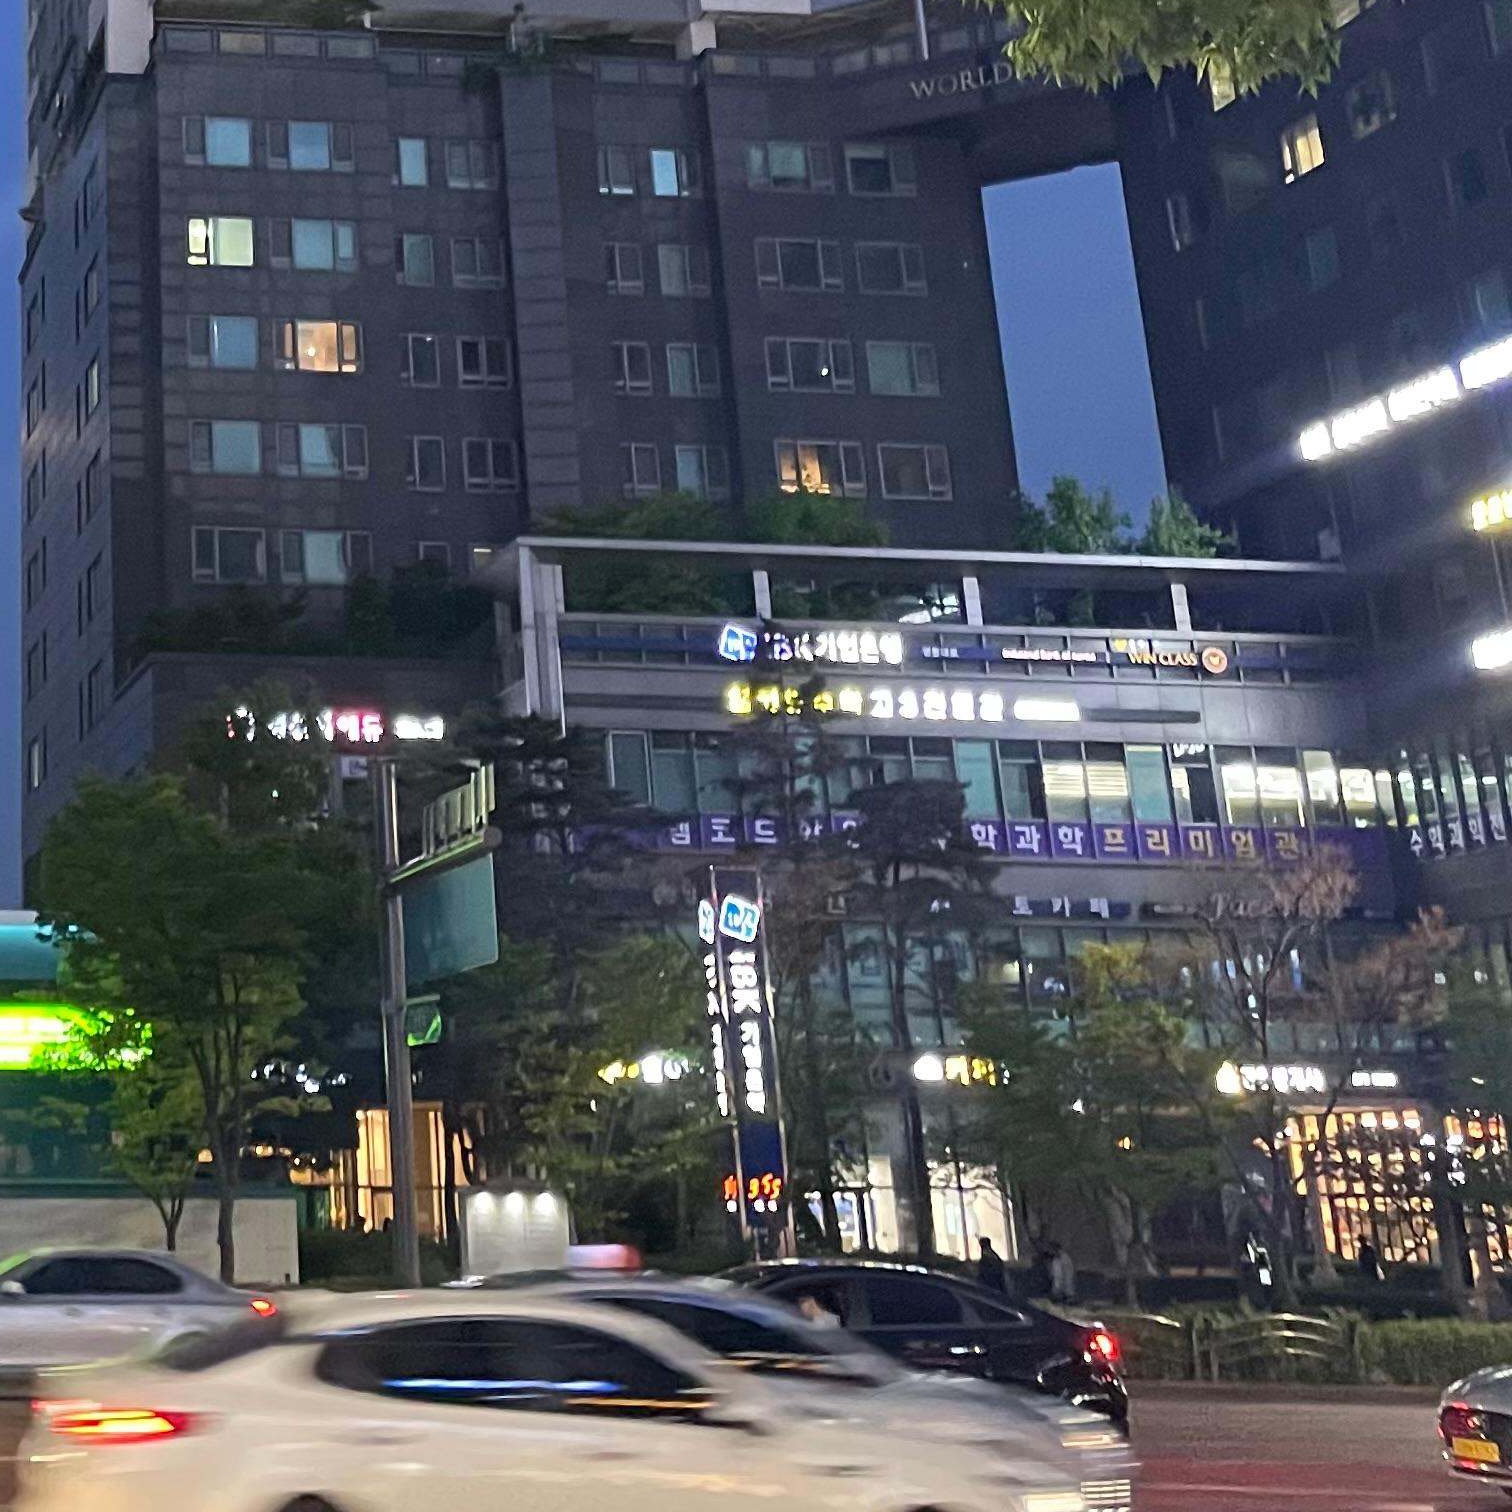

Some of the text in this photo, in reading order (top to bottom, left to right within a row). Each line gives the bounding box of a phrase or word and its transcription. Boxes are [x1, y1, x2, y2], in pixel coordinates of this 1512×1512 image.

[909, 62, 1013, 100] WORLD
[1128, 652, 1198, 666] WIN CLASS
